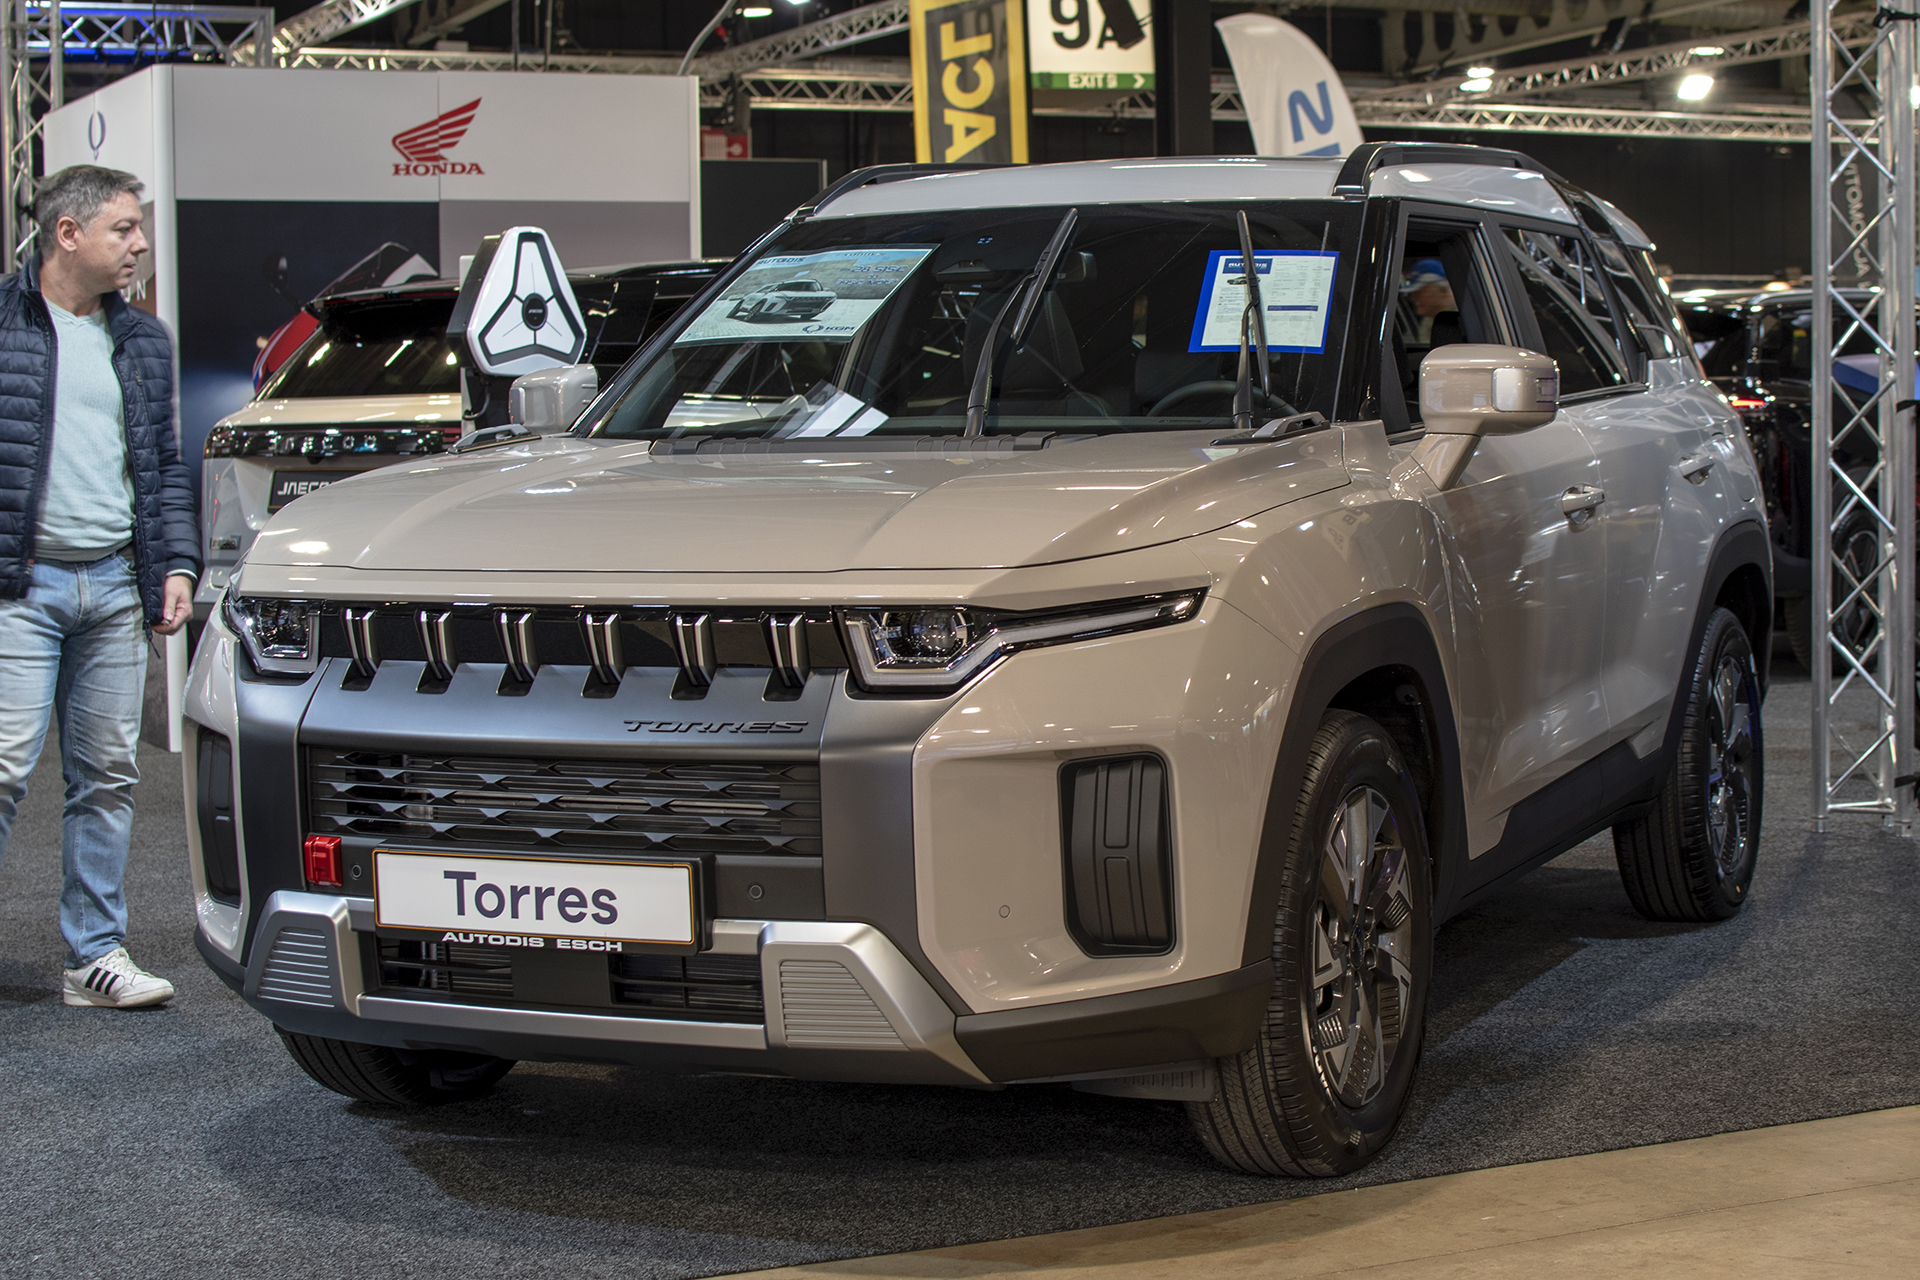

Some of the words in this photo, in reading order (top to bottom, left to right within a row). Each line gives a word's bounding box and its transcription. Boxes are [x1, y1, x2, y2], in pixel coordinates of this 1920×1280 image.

[1068, 73, 1105, 89] EXIT
[392, 162, 485, 176] HONDA
[277, 481, 335, 496] JAEC
[623, 719, 809, 734] TORRES
[443, 869, 619, 925] Torres
[441, 931, 545, 948] AUTODIS
[556, 938, 623, 952] ESCH
